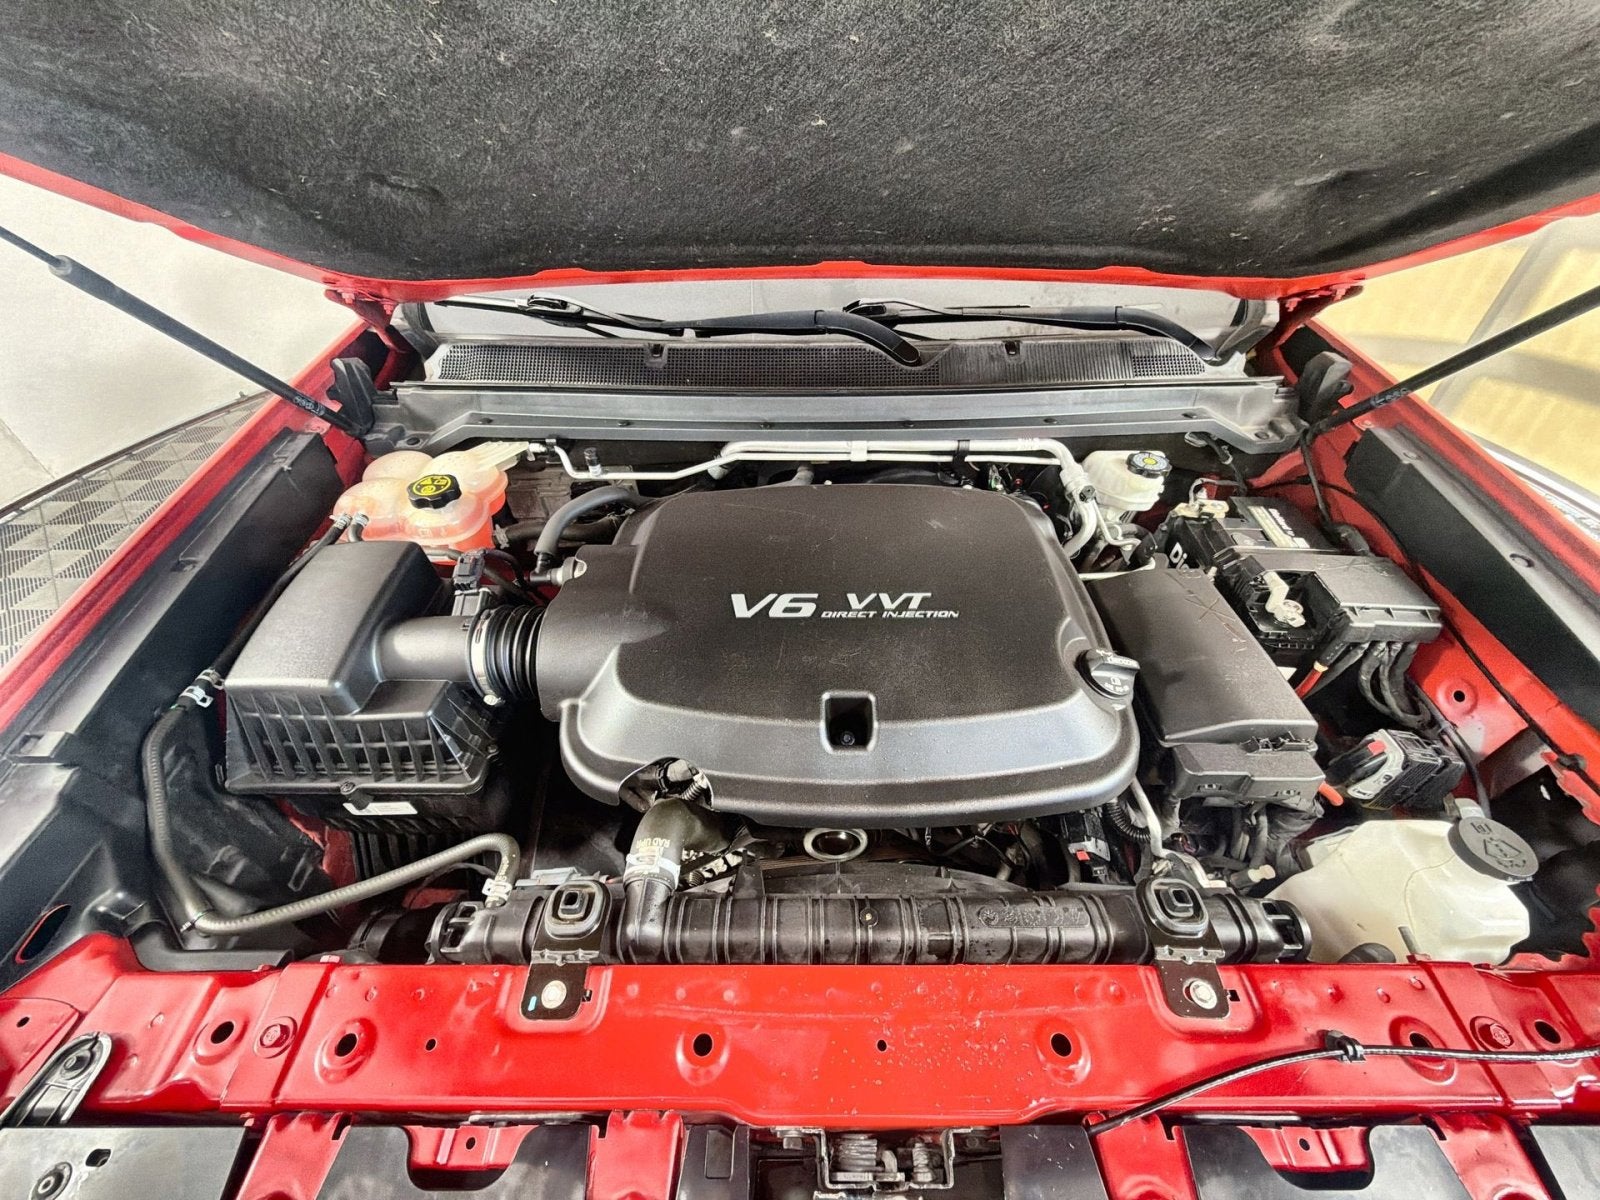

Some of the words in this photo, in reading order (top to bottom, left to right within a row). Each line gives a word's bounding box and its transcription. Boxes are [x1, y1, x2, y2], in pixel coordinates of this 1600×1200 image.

[730, 593, 819, 619] V6
[846, 592, 932, 610] VVT
[821, 610, 877, 619] DIRECT
[882, 610, 960, 619] INJECTION
